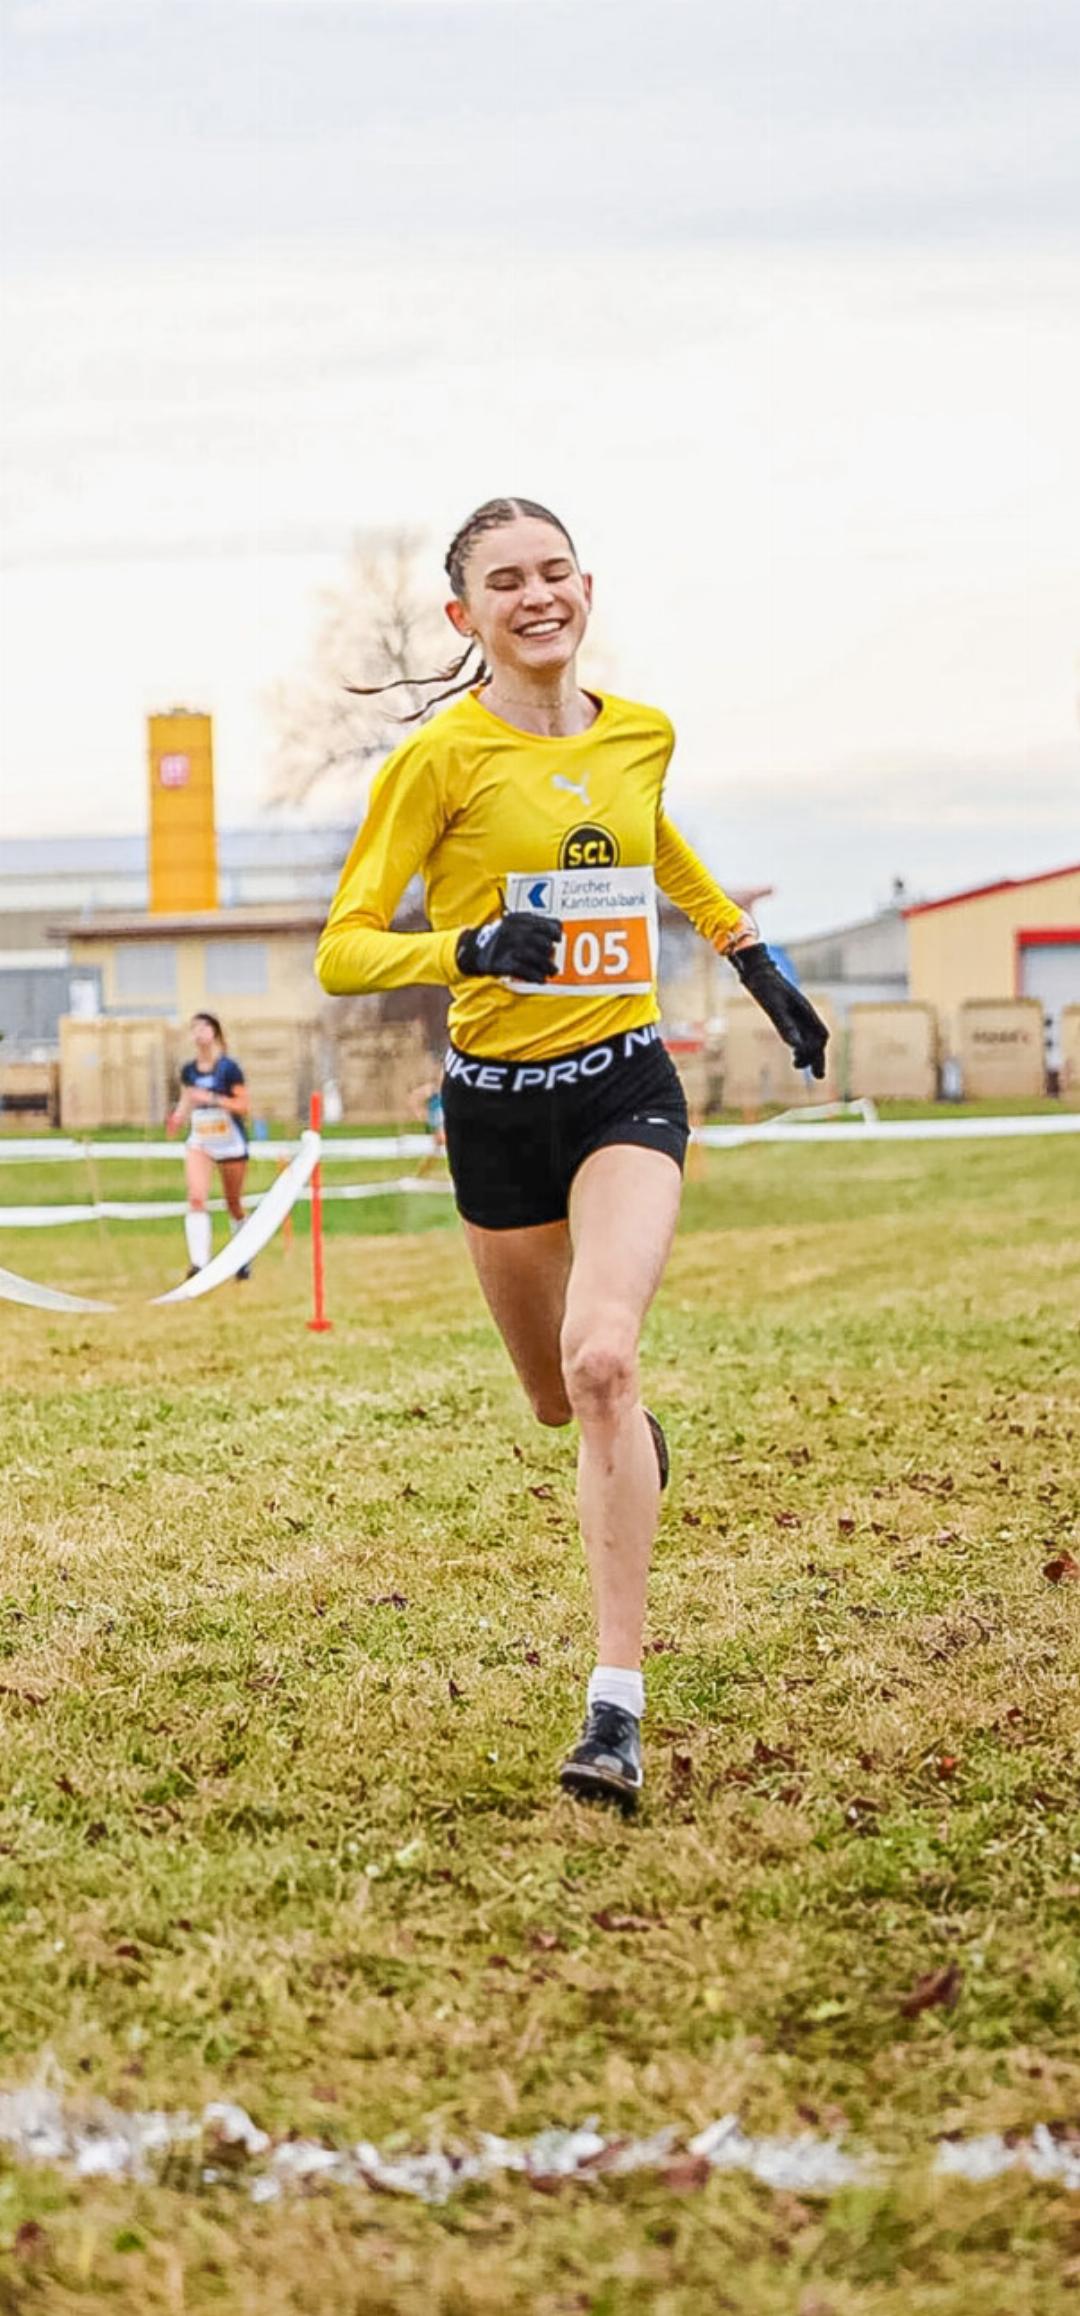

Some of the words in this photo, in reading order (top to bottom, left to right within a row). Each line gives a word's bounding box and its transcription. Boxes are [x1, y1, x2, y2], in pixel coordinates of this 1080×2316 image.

[568, 840, 610, 866] SCL
[561, 879, 610, 895] Zürcher
[512, 1047, 613, 1092] PRO
